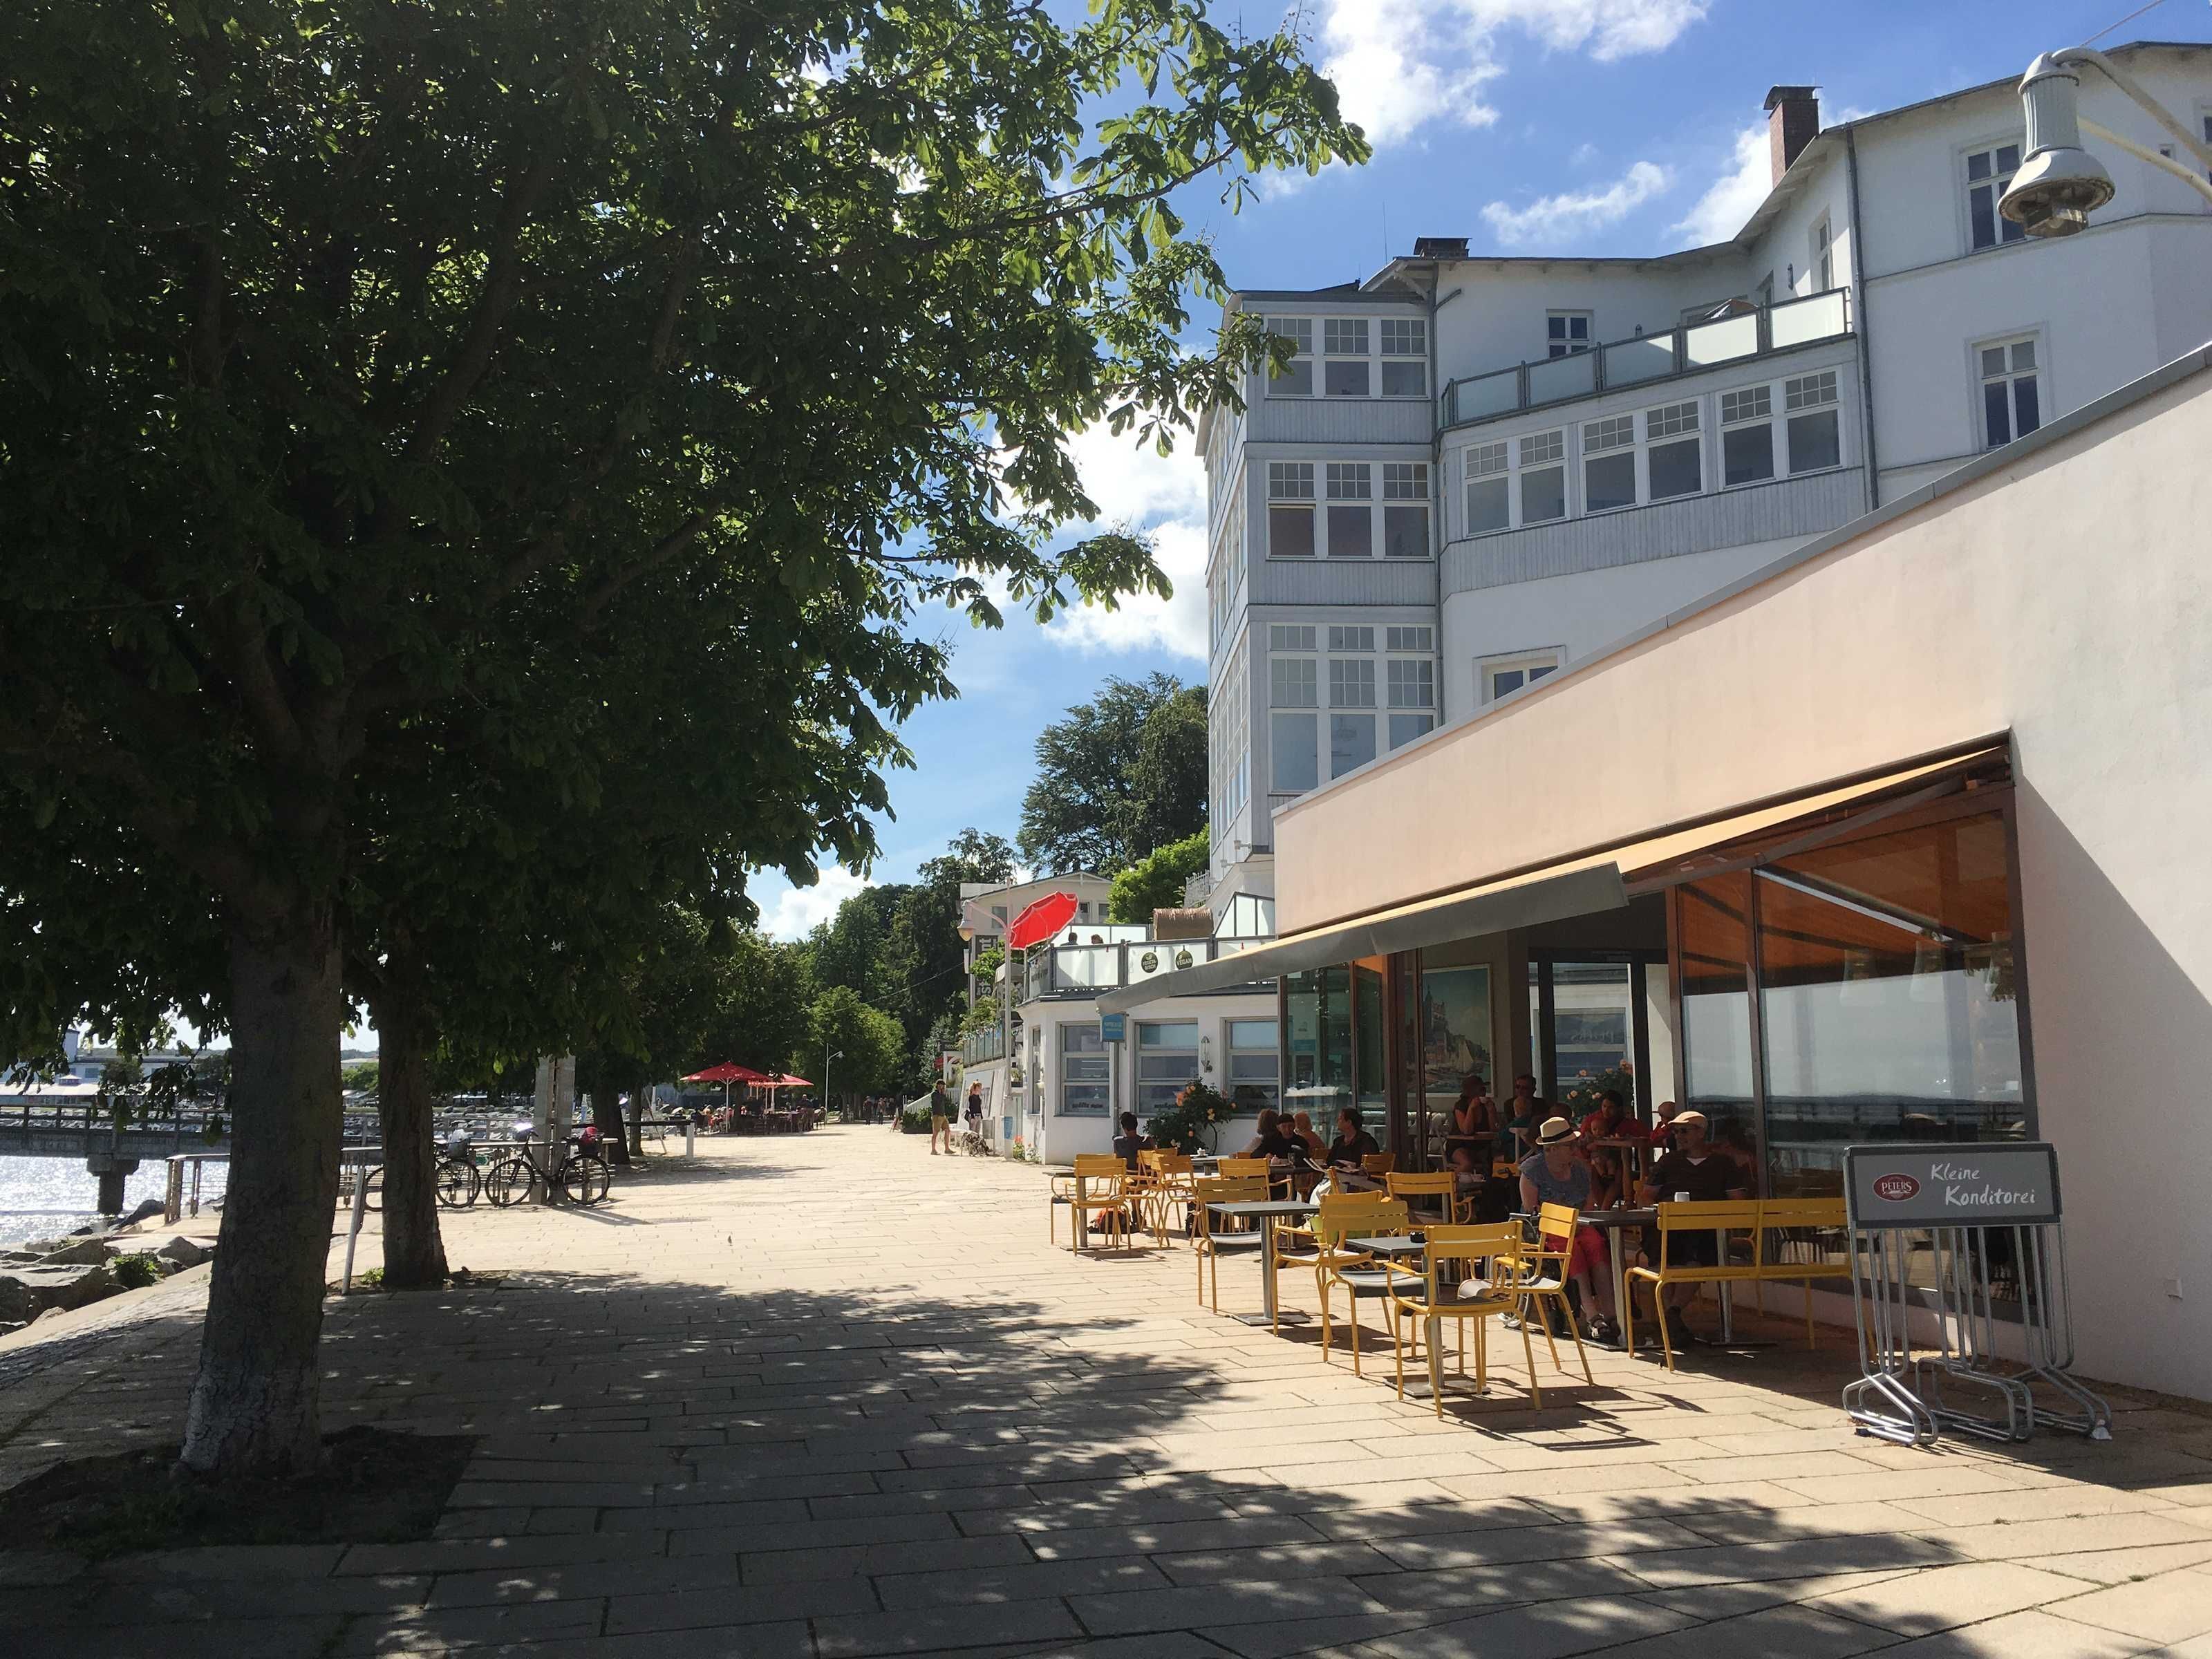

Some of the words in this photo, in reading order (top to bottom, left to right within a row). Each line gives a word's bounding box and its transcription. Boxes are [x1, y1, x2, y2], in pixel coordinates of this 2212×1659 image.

[1177, 957, 1192, 966] VEGAN
[1931, 1163, 1980, 1181] Kleine
[1882, 1181, 1913, 1194] PETERS
[1945, 1184, 2036, 1206] Konditorei
